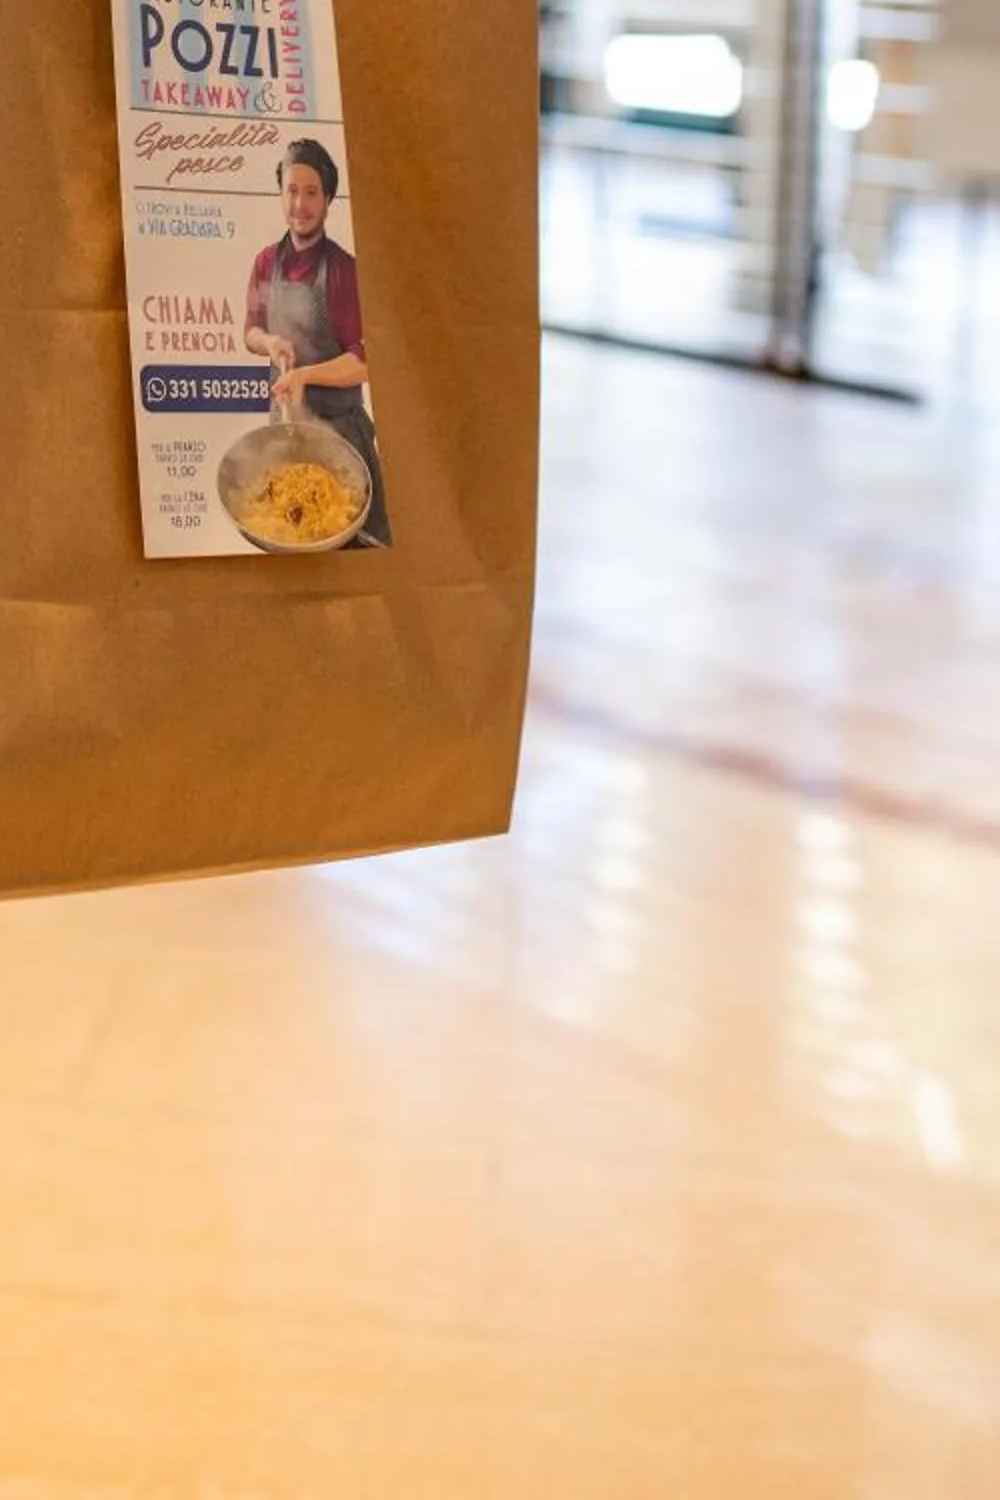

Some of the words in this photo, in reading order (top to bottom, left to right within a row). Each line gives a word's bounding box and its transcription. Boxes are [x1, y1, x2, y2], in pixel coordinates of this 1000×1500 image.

[140, 3, 279, 79] POZZI
[140, 79, 250, 111] TAKEAWAY
[253, 81, 283, 113] &
[133, 121, 280, 161] Specialità
[165, 154, 247, 184] pesce
[143, 295, 235, 325] CHIAMA
[145, 331, 154, 351] E
[161, 331, 237, 353] PRENOTA
[169, 379, 197, 398] 331
[203, 379, 270, 399] 5032528
